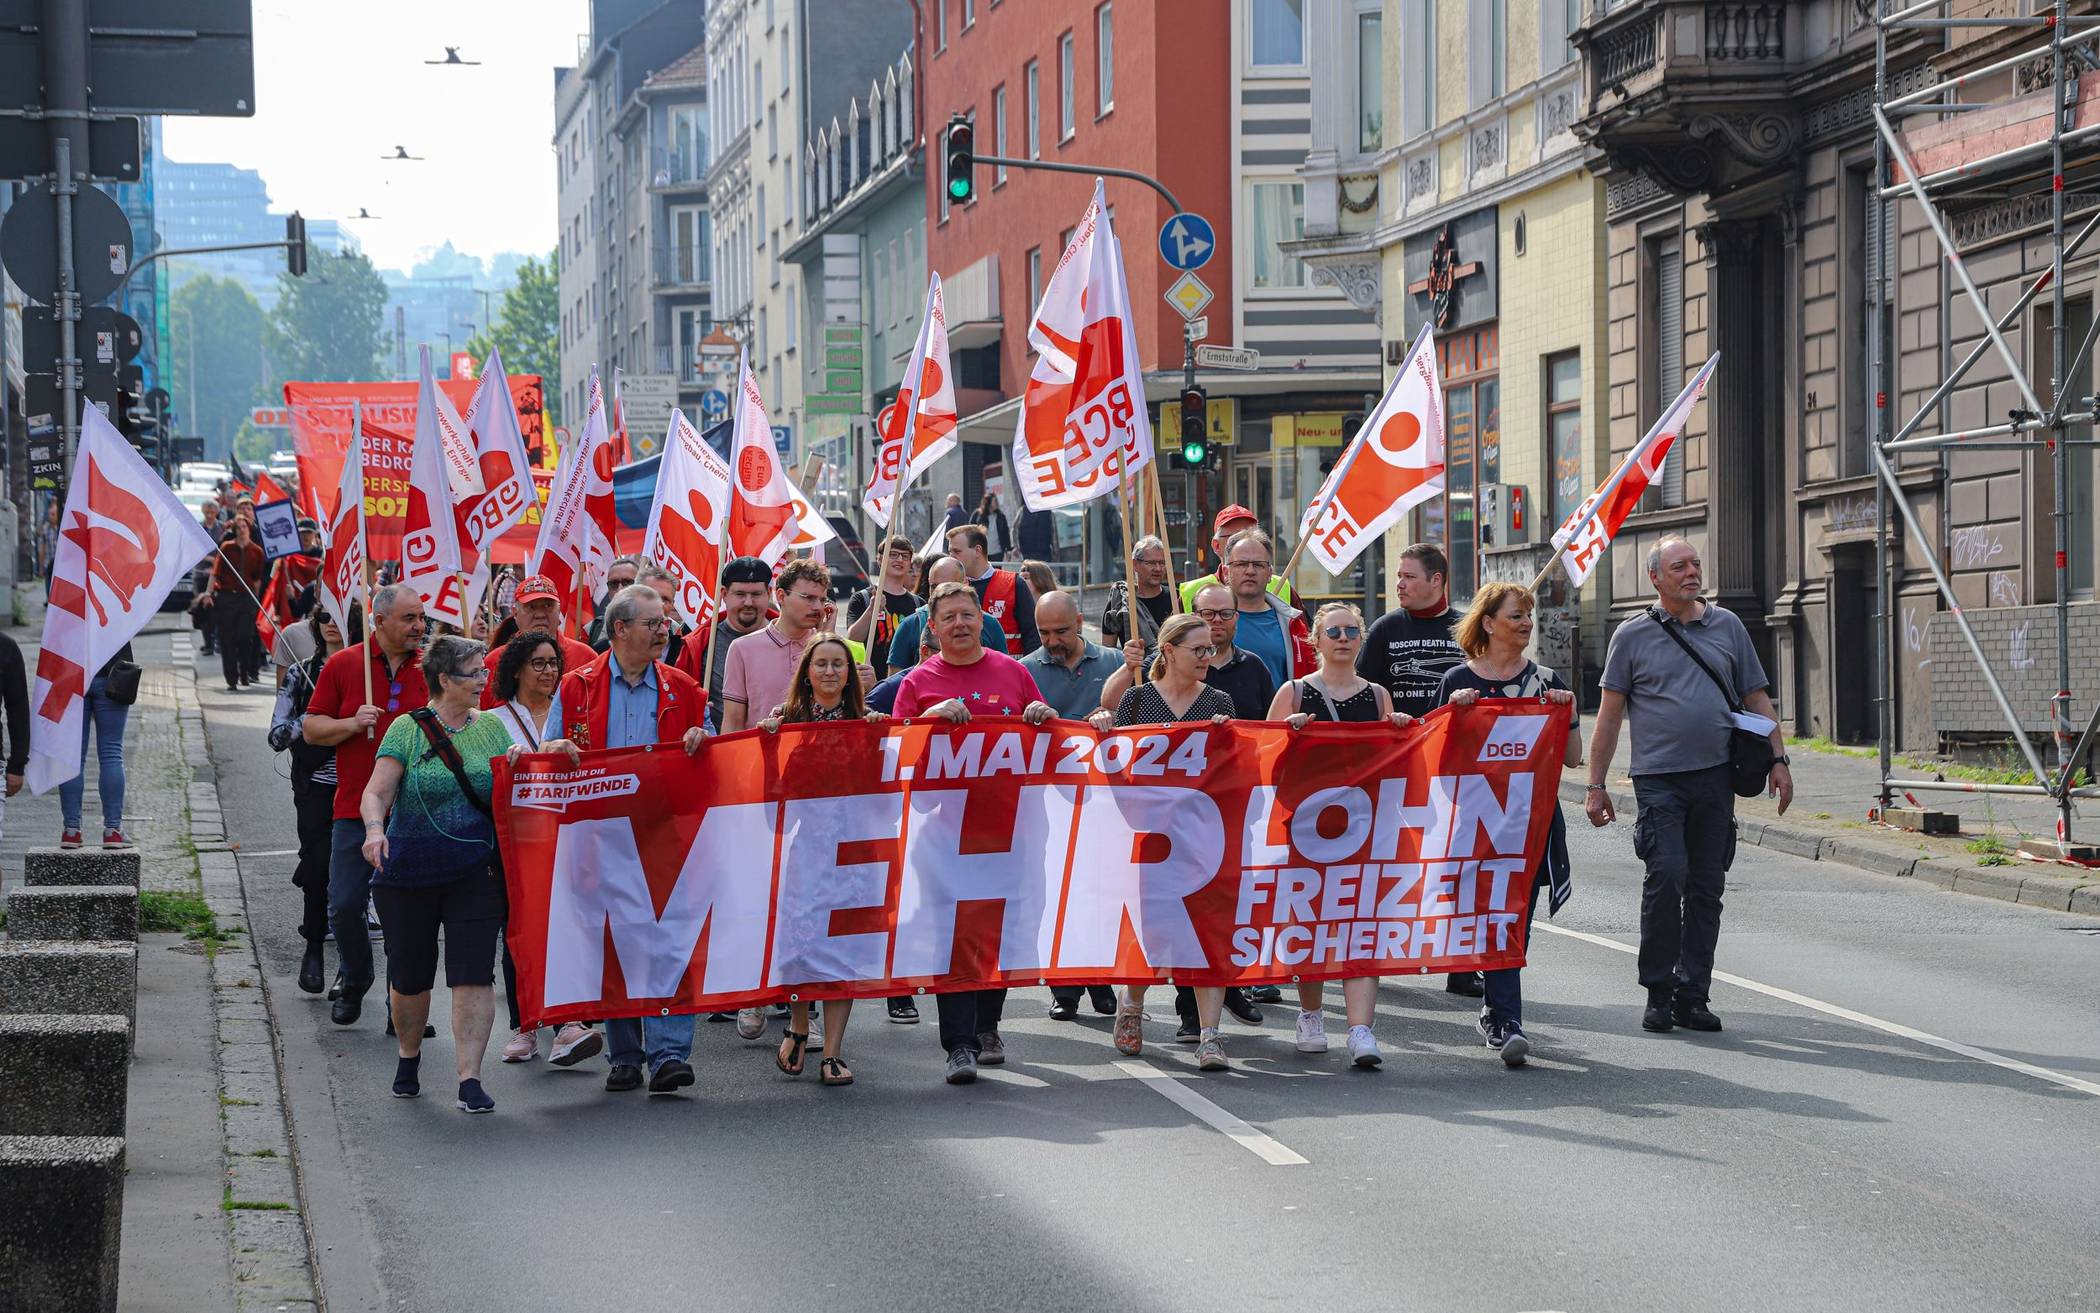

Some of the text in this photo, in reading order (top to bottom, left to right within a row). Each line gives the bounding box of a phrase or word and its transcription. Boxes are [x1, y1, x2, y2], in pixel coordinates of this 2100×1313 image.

[1207, 351, 1248, 364] Ernststraße
[1297, 427, 1326, 437] Neu-
[1389, 640, 1420, 649] MOSCOW
[1422, 639, 1445, 648] DEATH
[1393, 691, 1404, 699] NO
[1406, 690, 1425, 698] ONE
[925, 732, 1052, 780] MAI
[1055, 731, 1210, 777] 2024
[1487, 743, 1528, 759] DGB
[514, 767, 607, 781] EINTRETEN FÜR DIE
[516, 778, 632, 800] #TARIFWENDE
[1241, 772, 1535, 867] LOHN
[544, 784, 1225, 1008] MEHR
[1235, 859, 1527, 925] FREIZEIT
[1230, 913, 1520, 967] SICHERHEIT
